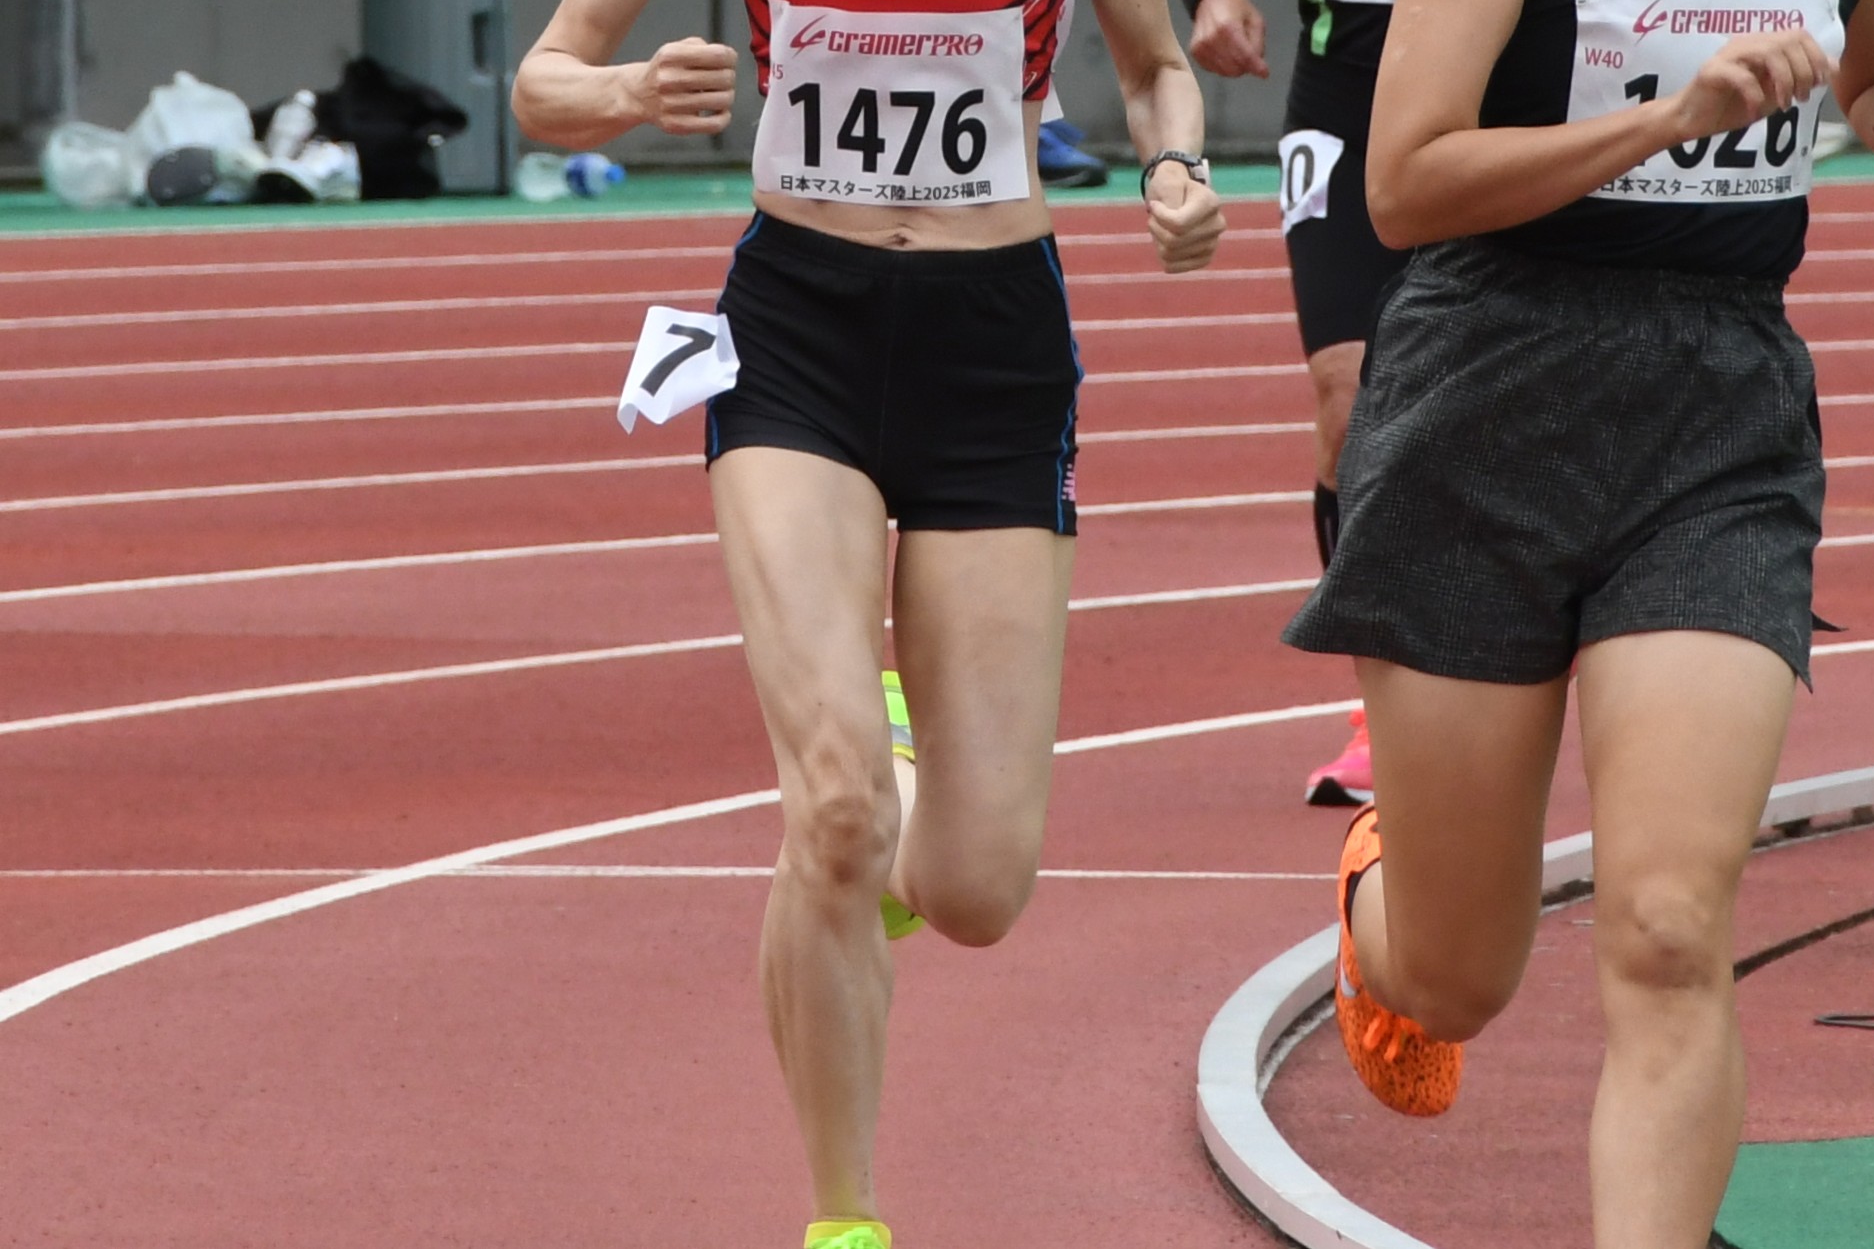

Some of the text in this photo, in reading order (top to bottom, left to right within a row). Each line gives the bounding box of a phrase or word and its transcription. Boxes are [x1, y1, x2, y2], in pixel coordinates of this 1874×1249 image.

[1584, 46, 1624, 69] W40
[788, 81, 988, 177] 1476
[780, 174, 993, 201] 日本マスターズ陸上2025福岡
[640, 322, 717, 397] 7
